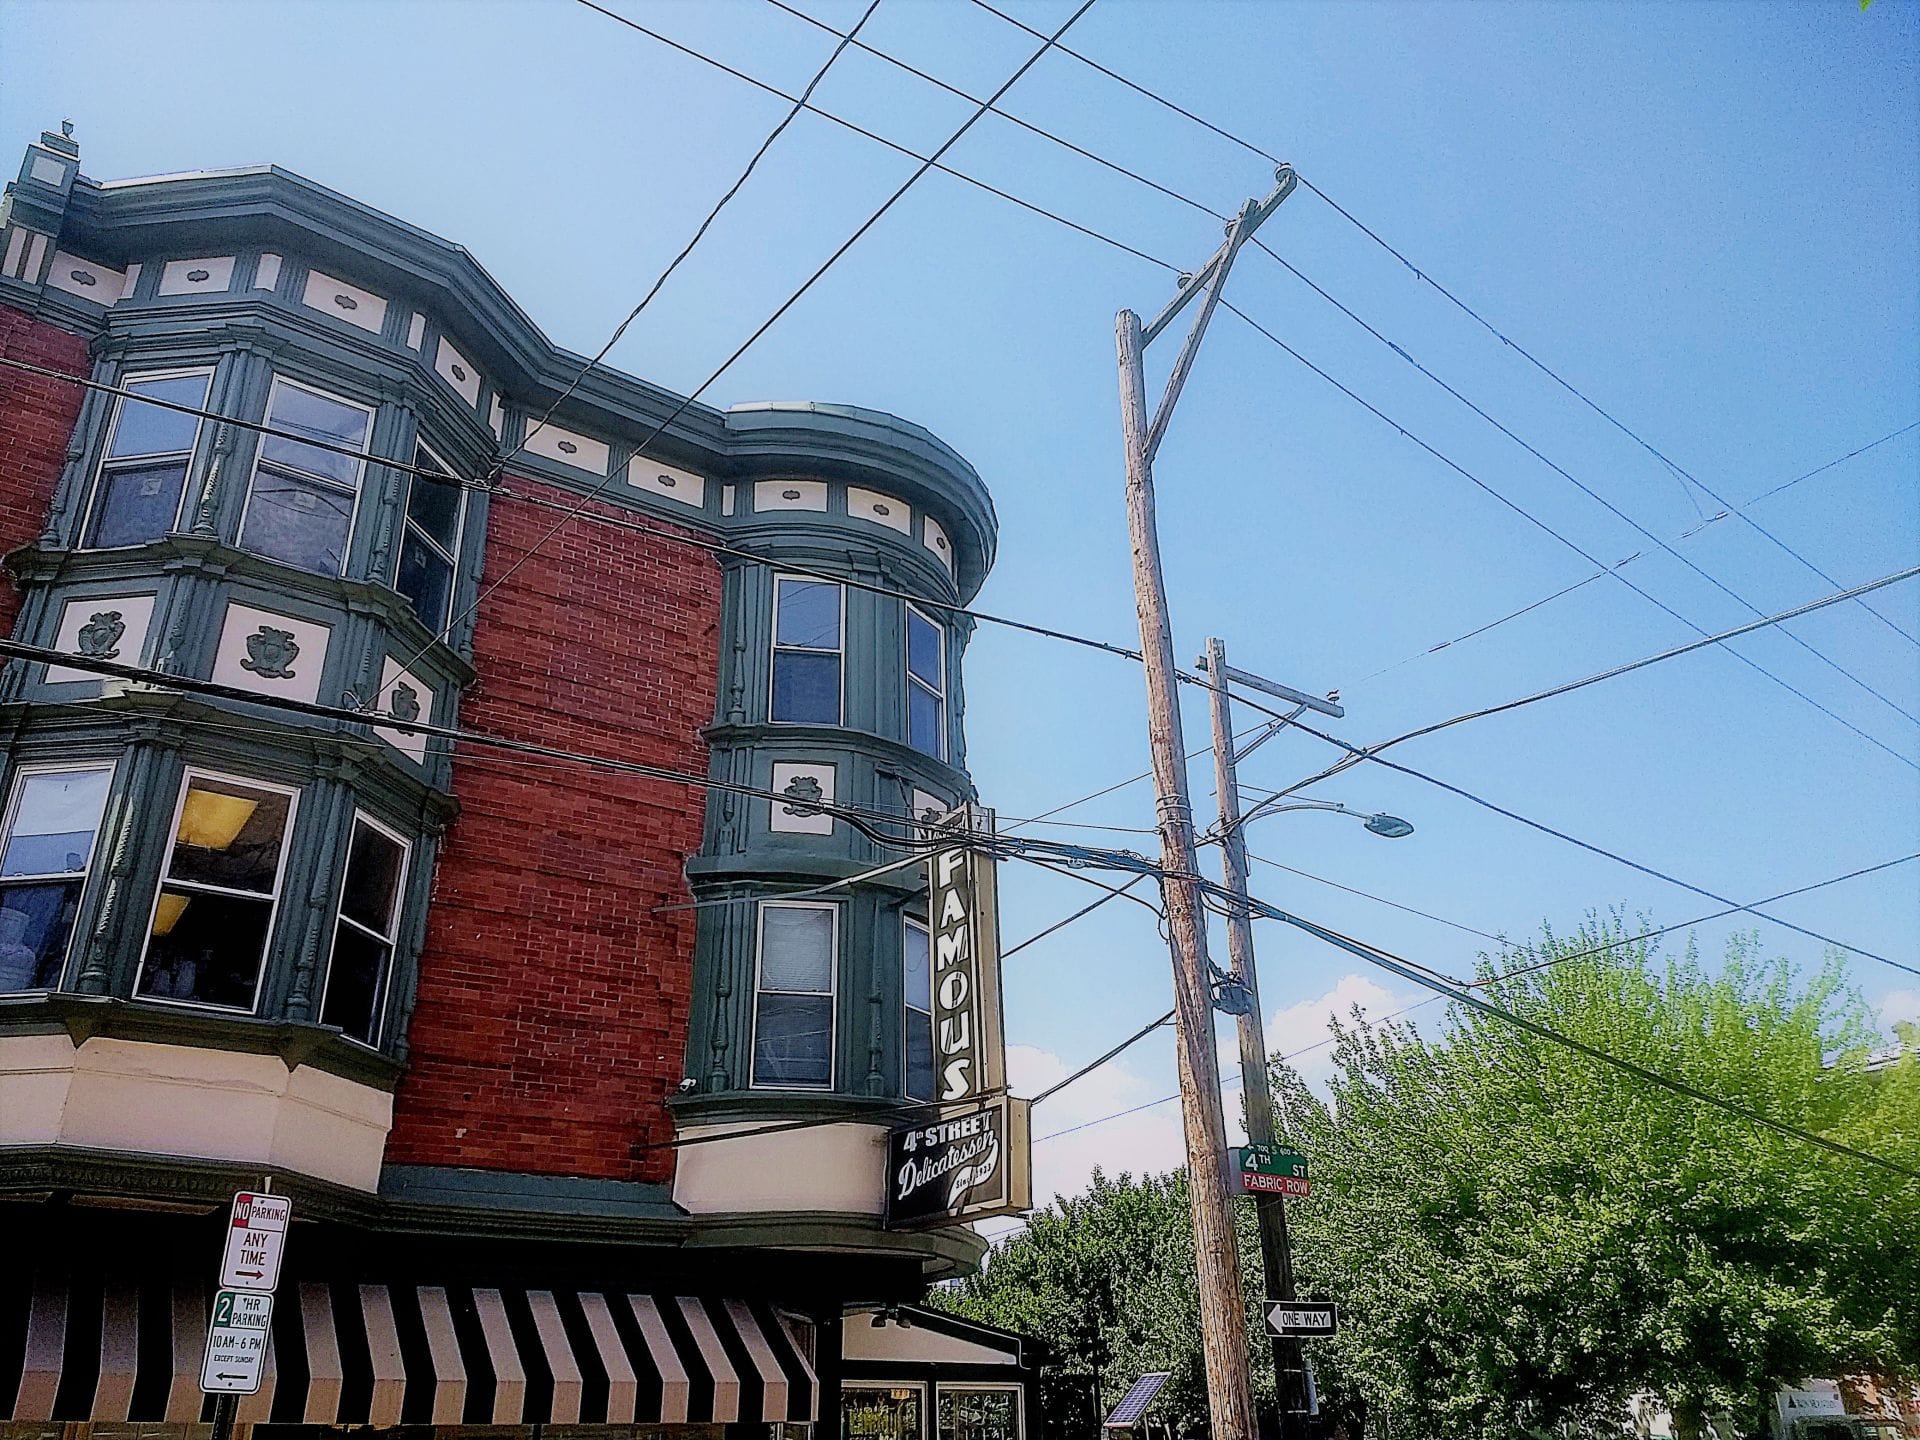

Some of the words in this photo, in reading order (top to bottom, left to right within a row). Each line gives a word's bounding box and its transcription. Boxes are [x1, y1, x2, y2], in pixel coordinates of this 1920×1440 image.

[937, 847, 970, 1101] FAMOUS
[925, 1110, 993, 1147] STREET
[1271, 1145, 1278, 1155] S
[898, 1129, 995, 1201] Delicatessen
[1245, 1153, 1271, 1171] 4TH
[1292, 1164, 1305, 1178] ST
[1244, 1174, 1283, 1191] FABRIC
[1286, 1180, 1308, 1194] ROW
[235, 1202, 250, 1220] NO
[251, 1206, 286, 1221] PARKING
[243, 1232, 268, 1248] ANY
[240, 1249, 267, 1266] TIME
[217, 1297, 231, 1322] 2
[246, 1298, 261, 1311] HR
[232, 1312, 267, 1327] PARKING
[1282, 1312, 1299, 1326] ONE
[1304, 1312, 1327, 1326] WAY
[249, 1338, 262, 1350] PM
[214, 1354, 234, 1363] EXCEPT
[234, 1355, 255, 1364] SUNDAY
